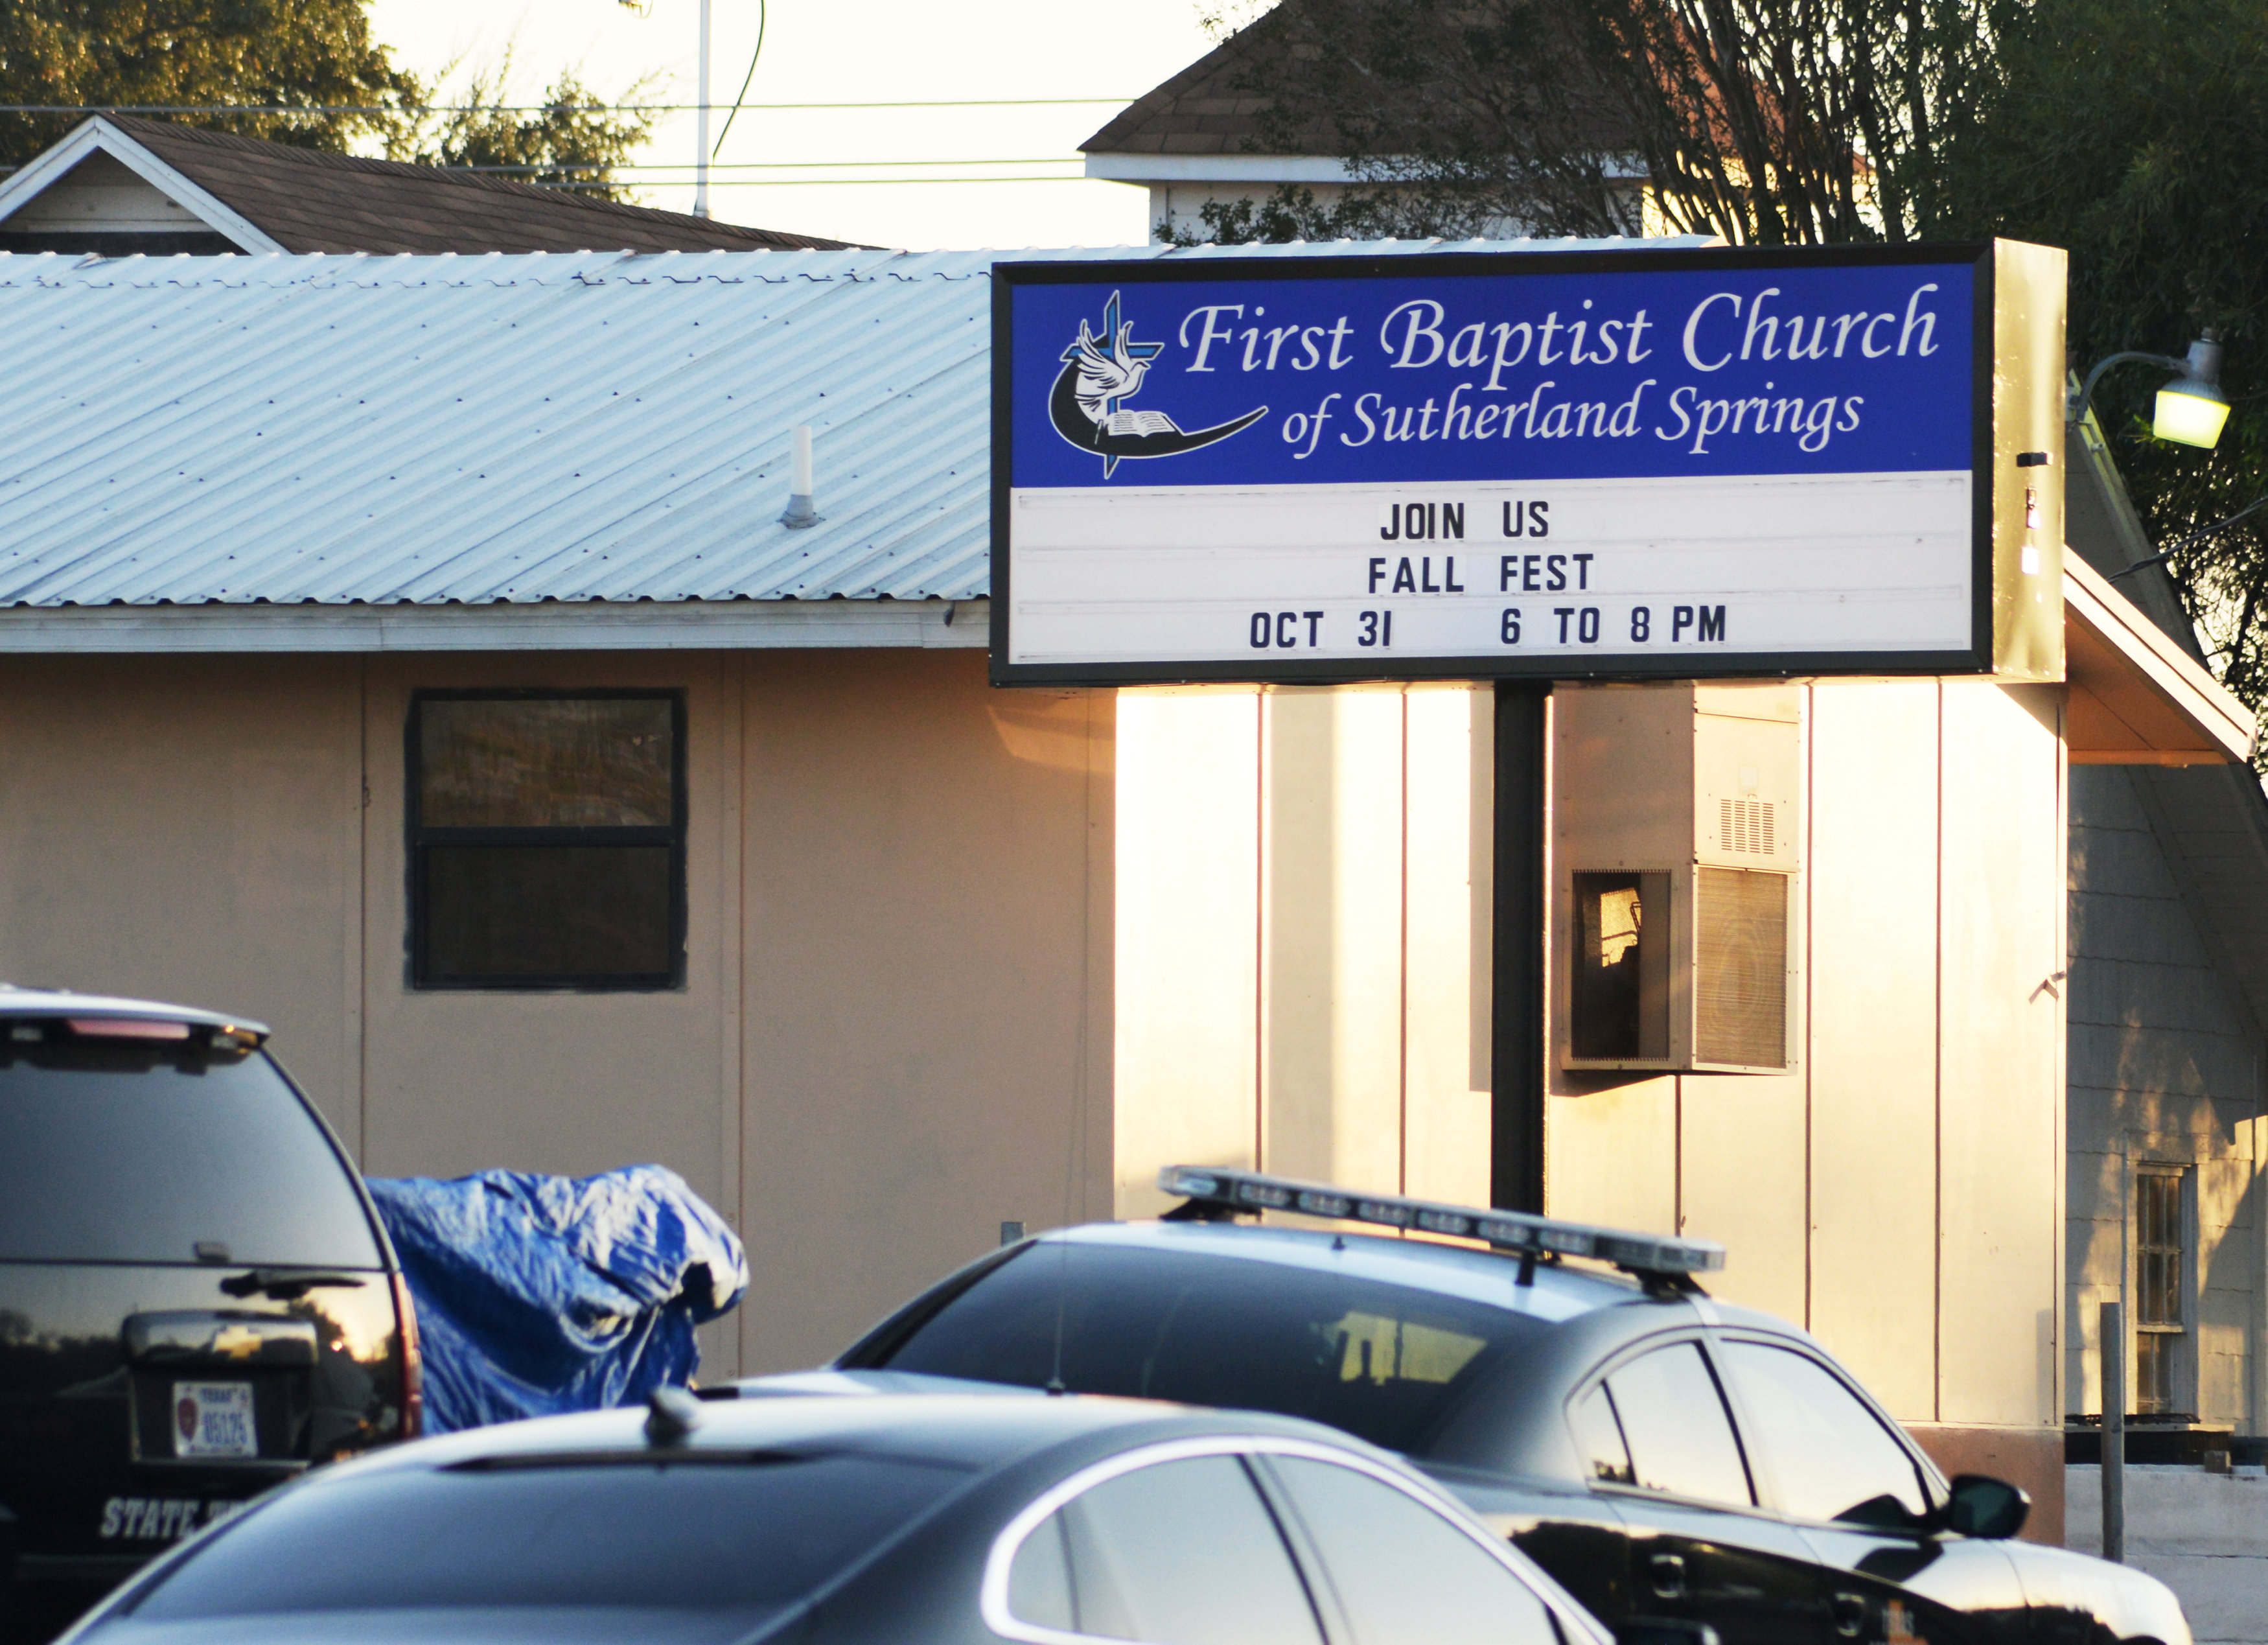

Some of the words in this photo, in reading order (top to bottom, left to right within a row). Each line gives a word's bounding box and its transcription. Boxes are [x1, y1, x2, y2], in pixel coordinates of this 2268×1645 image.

[1180, 305, 1354, 373] First
[1381, 300, 1654, 391] Baptist
[1684, 284, 1939, 371] Church
[1283, 393, 1341, 459] of
[1341, 379, 1656, 446] Sutherland
[1656, 382, 1864, 454] Springs
[1381, 503, 1464, 541] JOIN
[1503, 501, 1549, 537] US
[1369, 556, 1464, 594] FALL
[1501, 554, 1594, 592] FEST
[1250, 611, 1325, 648] OCT
[1358, 611, 1392, 646] 31
[1501, 608, 1522, 644] 6
[1554, 607, 1601, 644] TO
[1631, 607, 1650, 643] 8
[1672, 605, 1726, 642] PM
[100, 1497, 201, 1539] STATE
